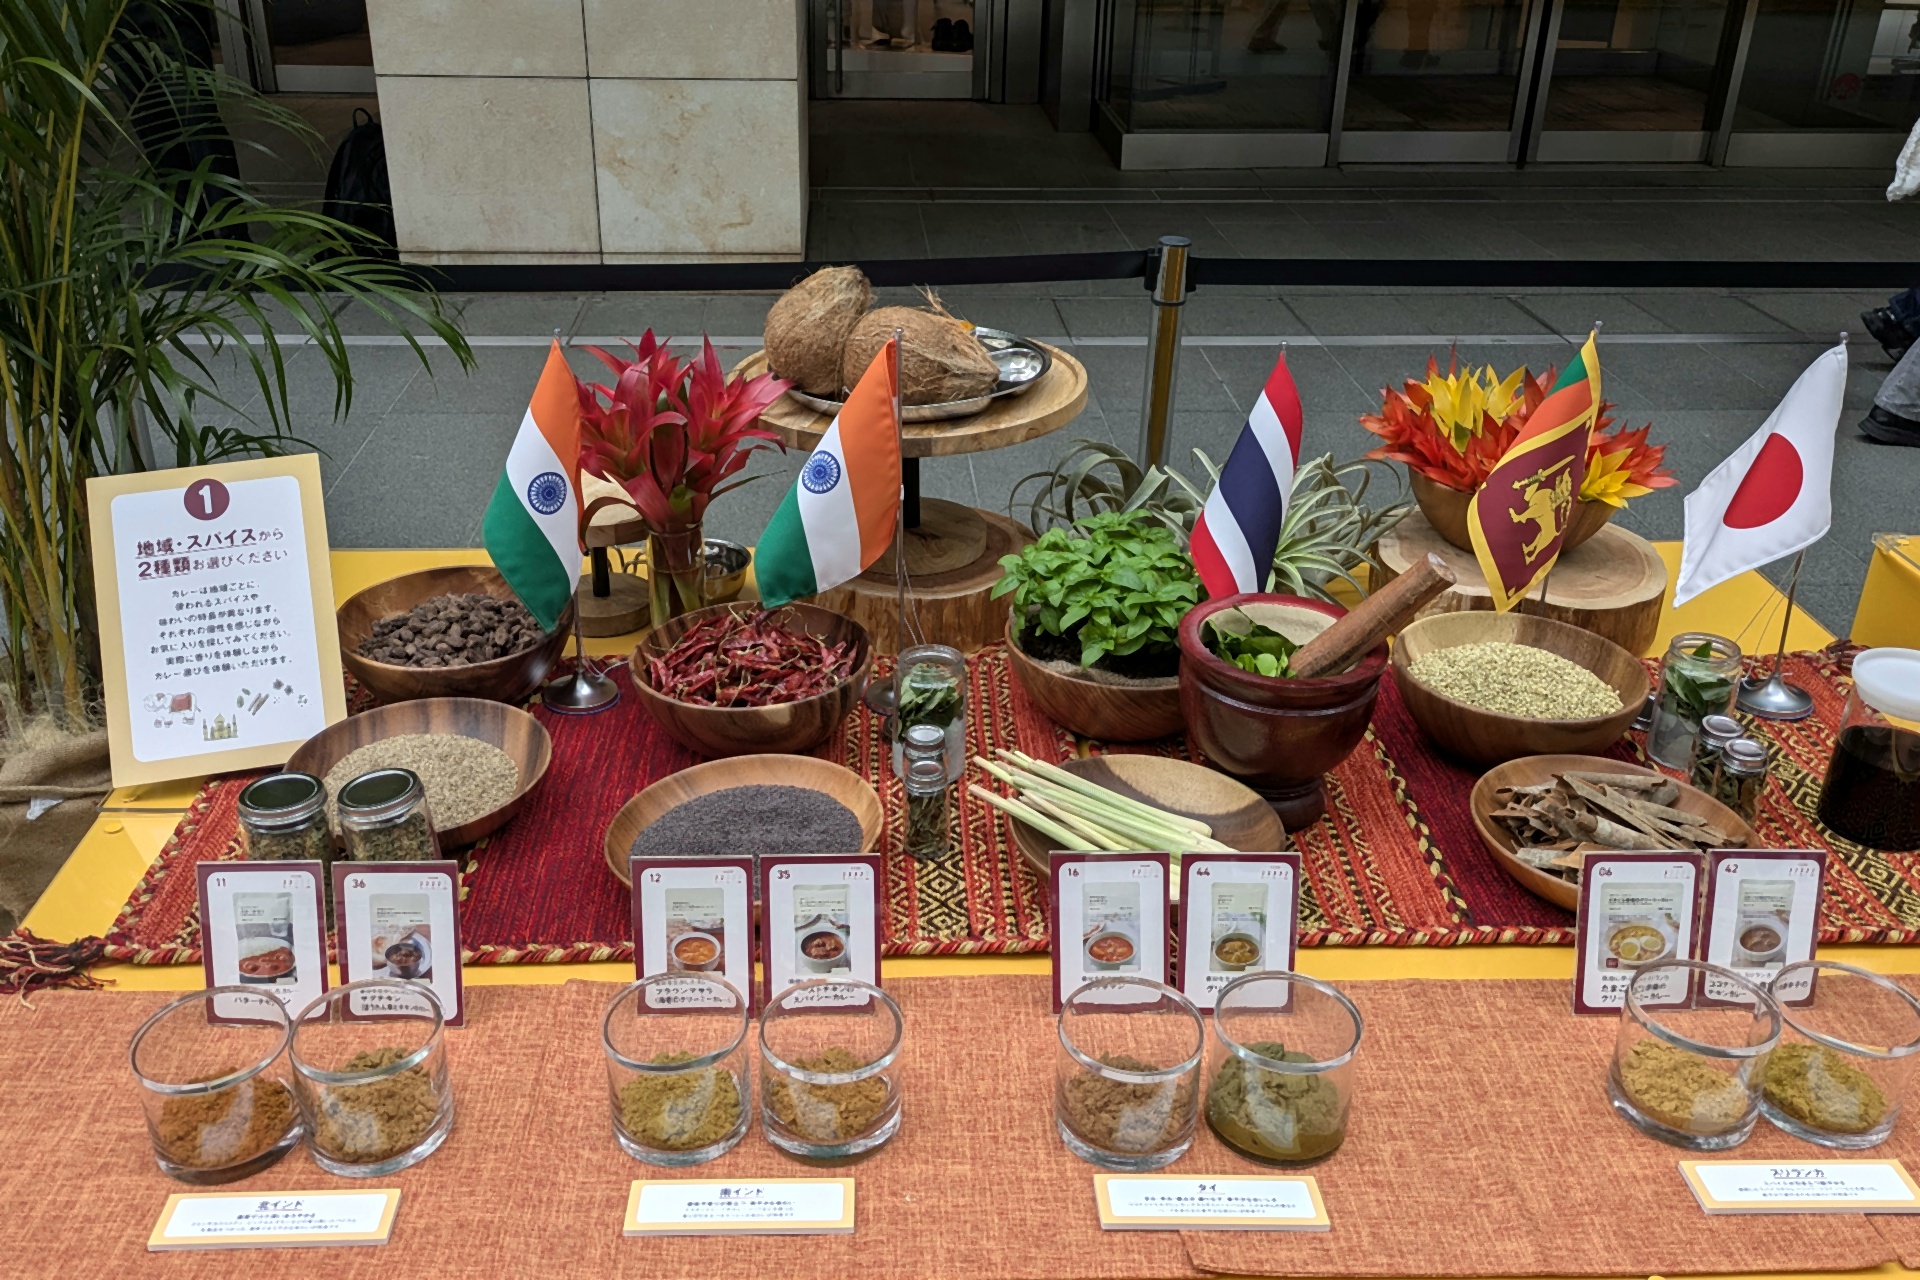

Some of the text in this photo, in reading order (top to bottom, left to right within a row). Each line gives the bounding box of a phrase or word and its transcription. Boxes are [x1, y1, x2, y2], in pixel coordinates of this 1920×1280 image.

[198, 485, 212, 515] 1
[137, 528, 284, 557] 地域・スパイスから
[138, 550, 288, 578] 2種類お選びください
[777, 870, 791, 880] 35
[1068, 868, 1080, 878] 16
[1598, 867, 1613, 877] 06
[1725, 864, 1739, 875] 42
[216, 877, 227, 888] 11
[351, 878, 367, 890] 36
[649, 873, 662, 884] 12
